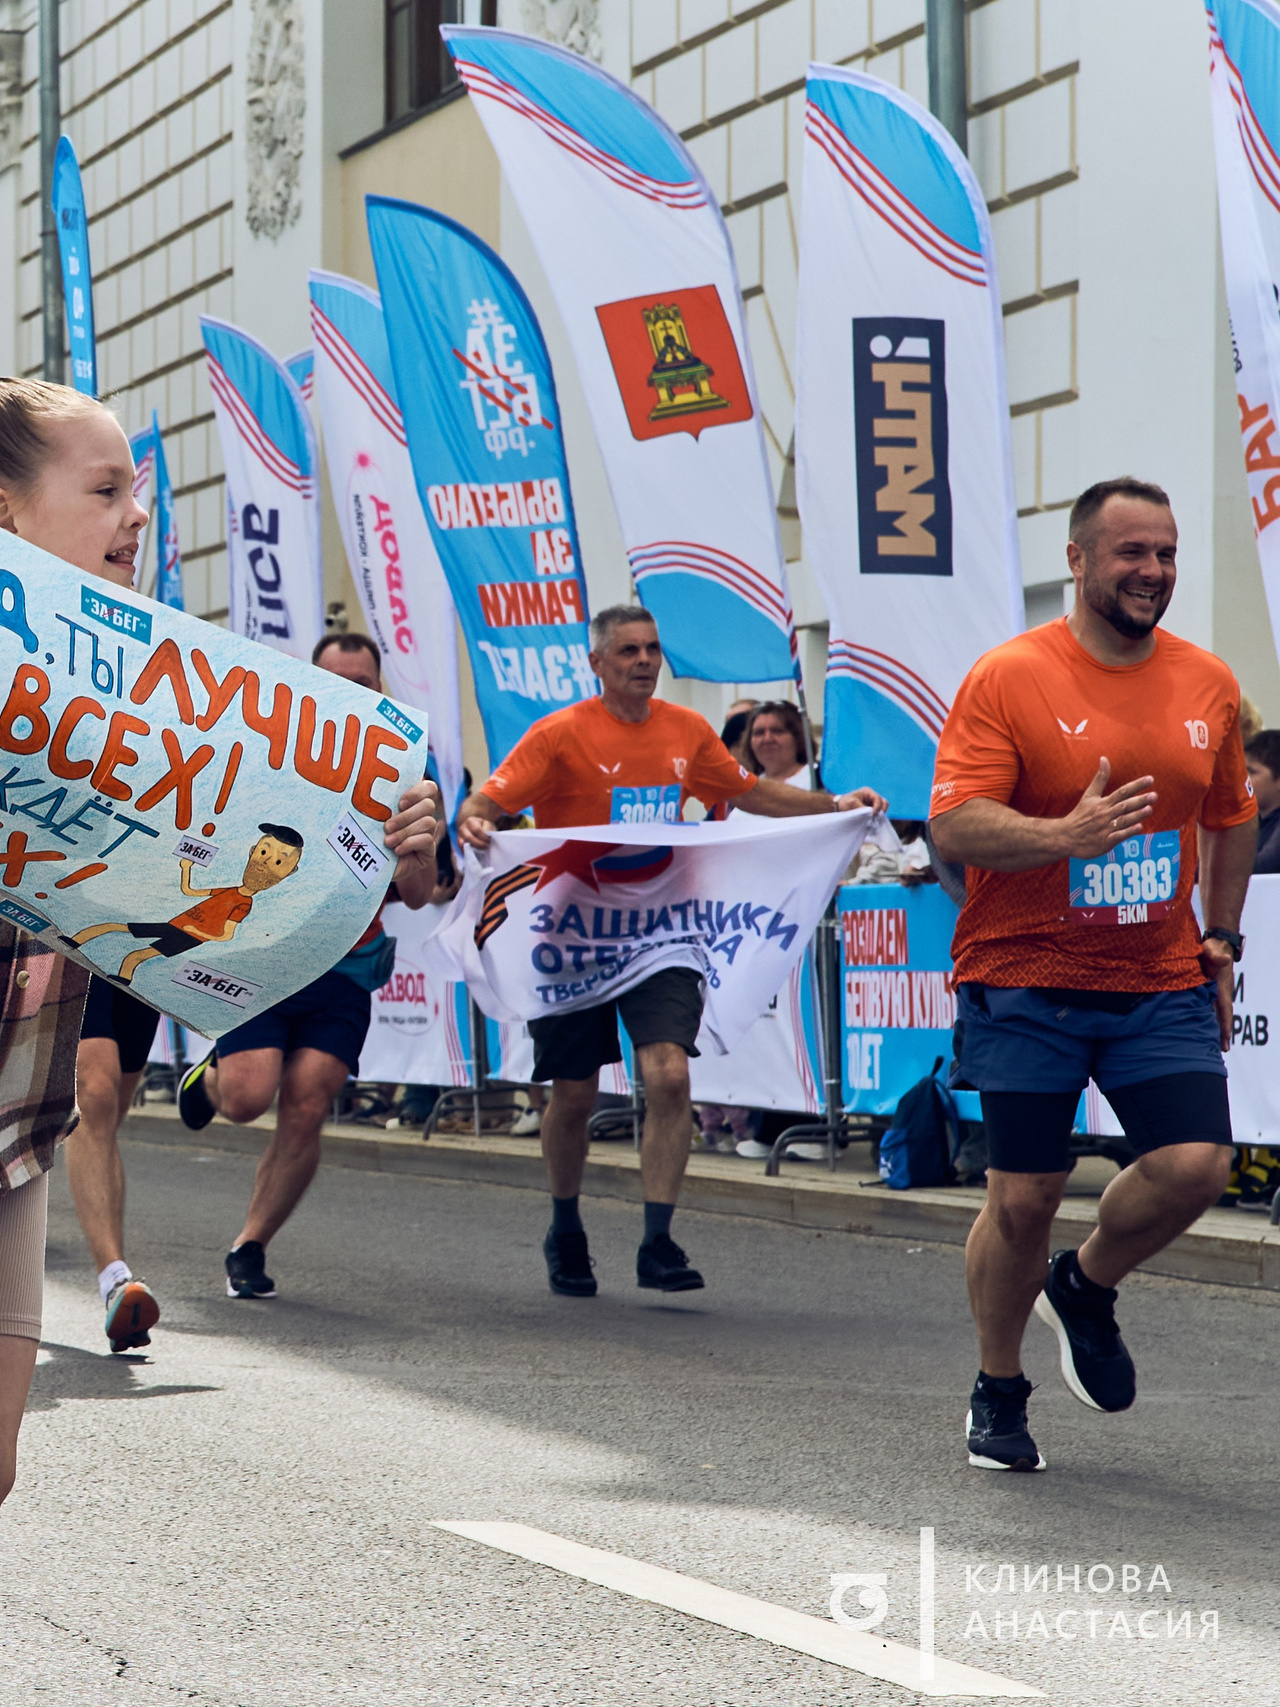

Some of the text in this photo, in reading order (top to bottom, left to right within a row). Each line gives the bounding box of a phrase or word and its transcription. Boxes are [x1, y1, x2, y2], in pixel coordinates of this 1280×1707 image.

[56, 613, 124, 699] ТЫ
[131, 638, 408, 823] ЛУЧШЕ
[1083, 856, 1172, 905] 30383
[529, 899, 799, 952] ЗАЩИТНИКИ
[912, 971, 959, 1030] КУЛЬ
[1231, 1014, 1269, 1046] РАВ
